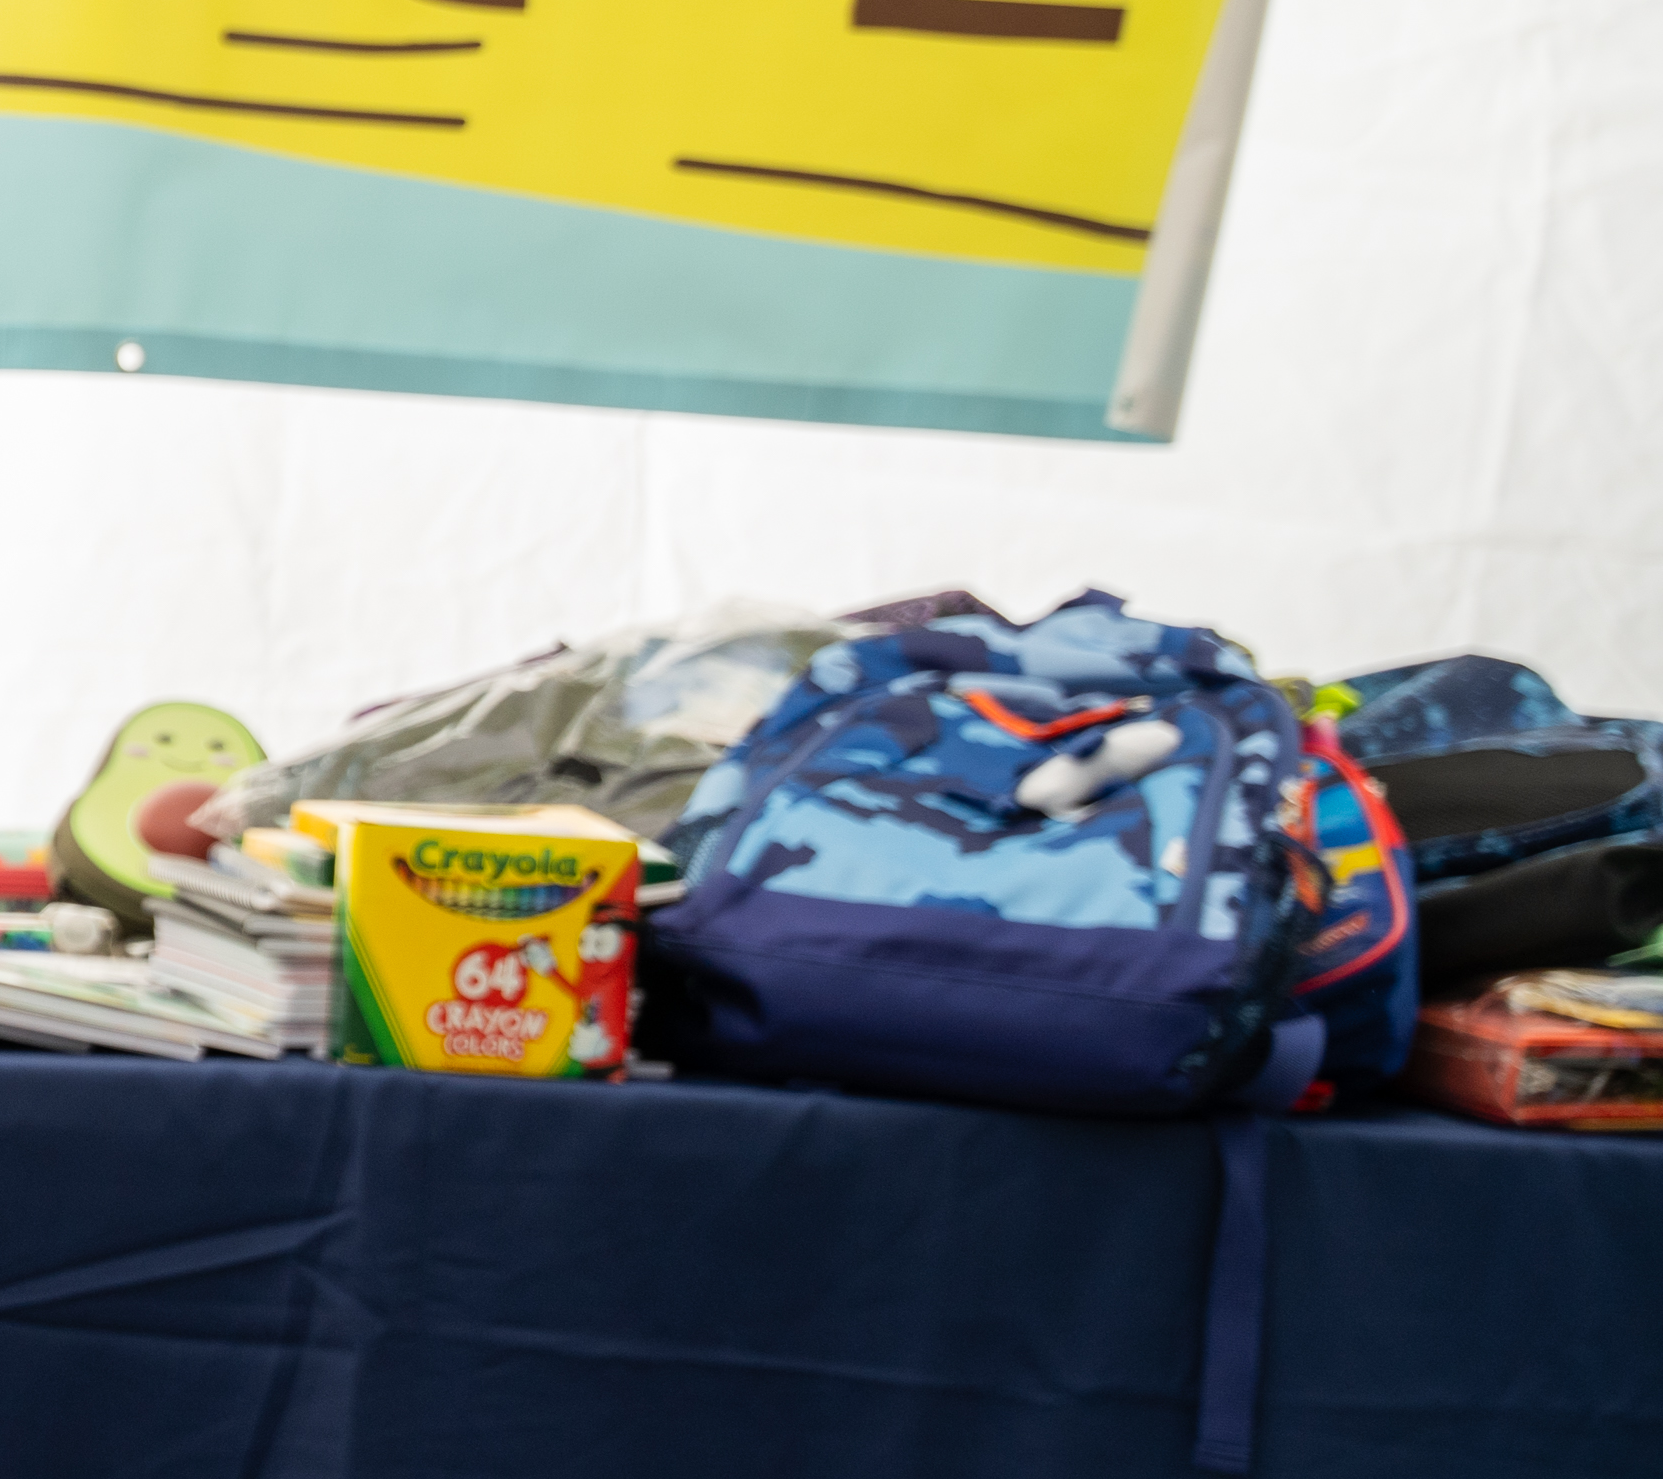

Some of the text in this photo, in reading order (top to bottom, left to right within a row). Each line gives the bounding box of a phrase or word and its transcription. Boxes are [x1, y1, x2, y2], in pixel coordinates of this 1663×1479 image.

[413, 840, 578, 880] Crayola
[454, 948, 522, 1002] 64
[426, 1001, 548, 1040] CRAYON
[443, 1030, 526, 1062] COLORS
